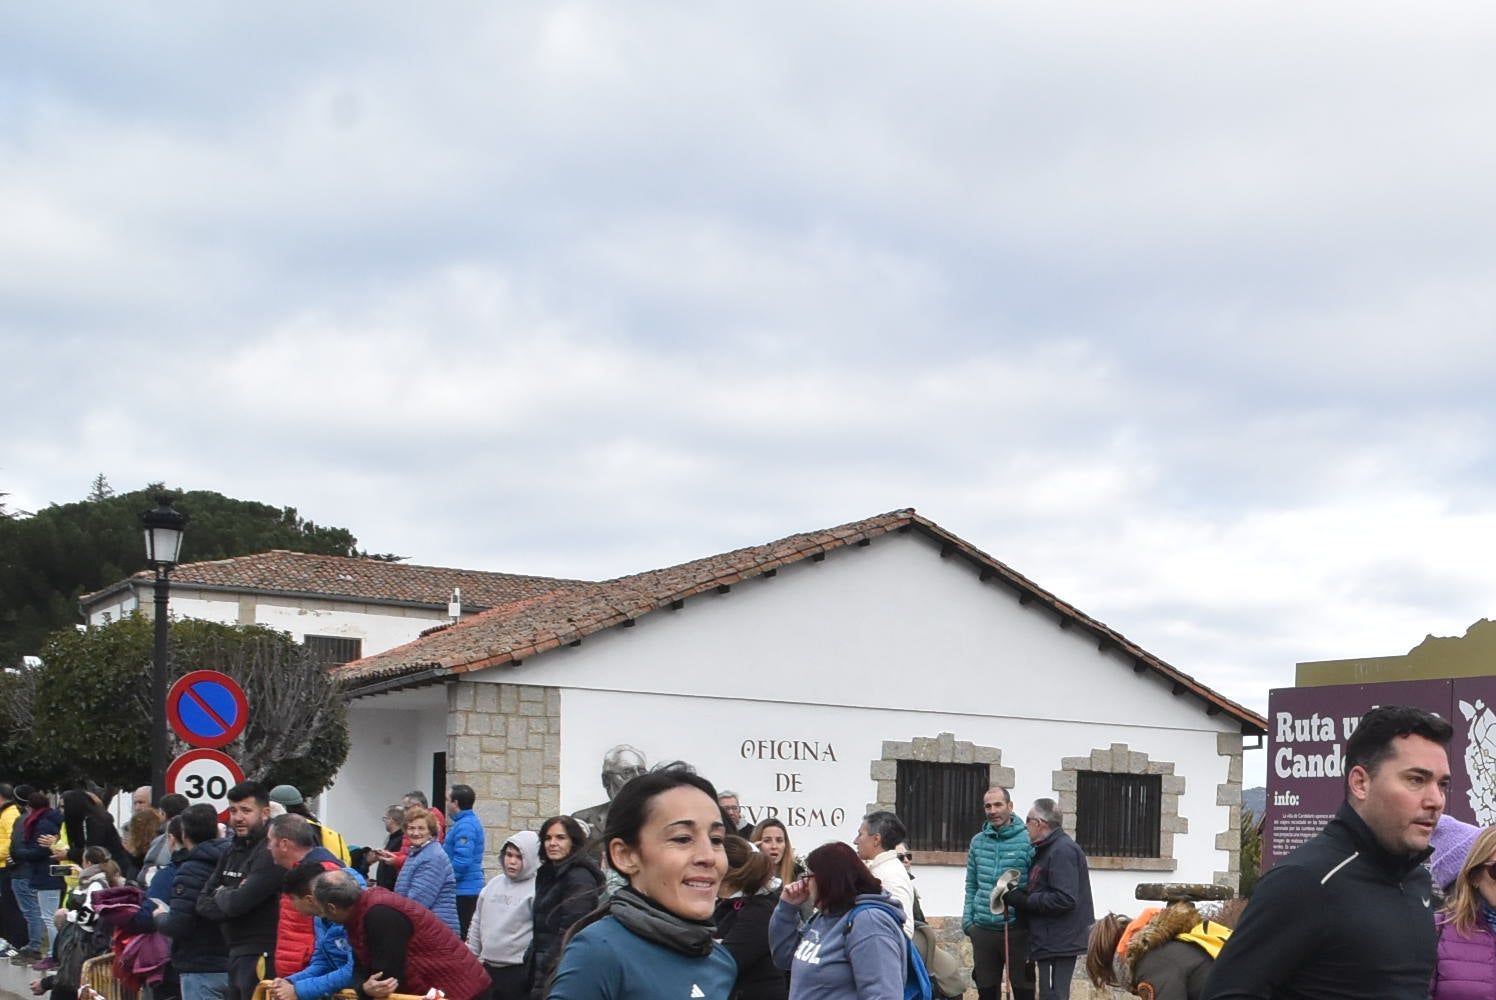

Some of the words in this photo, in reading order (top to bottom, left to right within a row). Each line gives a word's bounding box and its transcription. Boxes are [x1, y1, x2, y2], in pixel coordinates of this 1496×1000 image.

[1276, 712, 1336, 743] Ruta
[741, 739, 838, 762] OFICINA
[185, 774, 228, 800] 30
[775, 772, 803, 793] DE
[1274, 790, 1300, 806] info:
